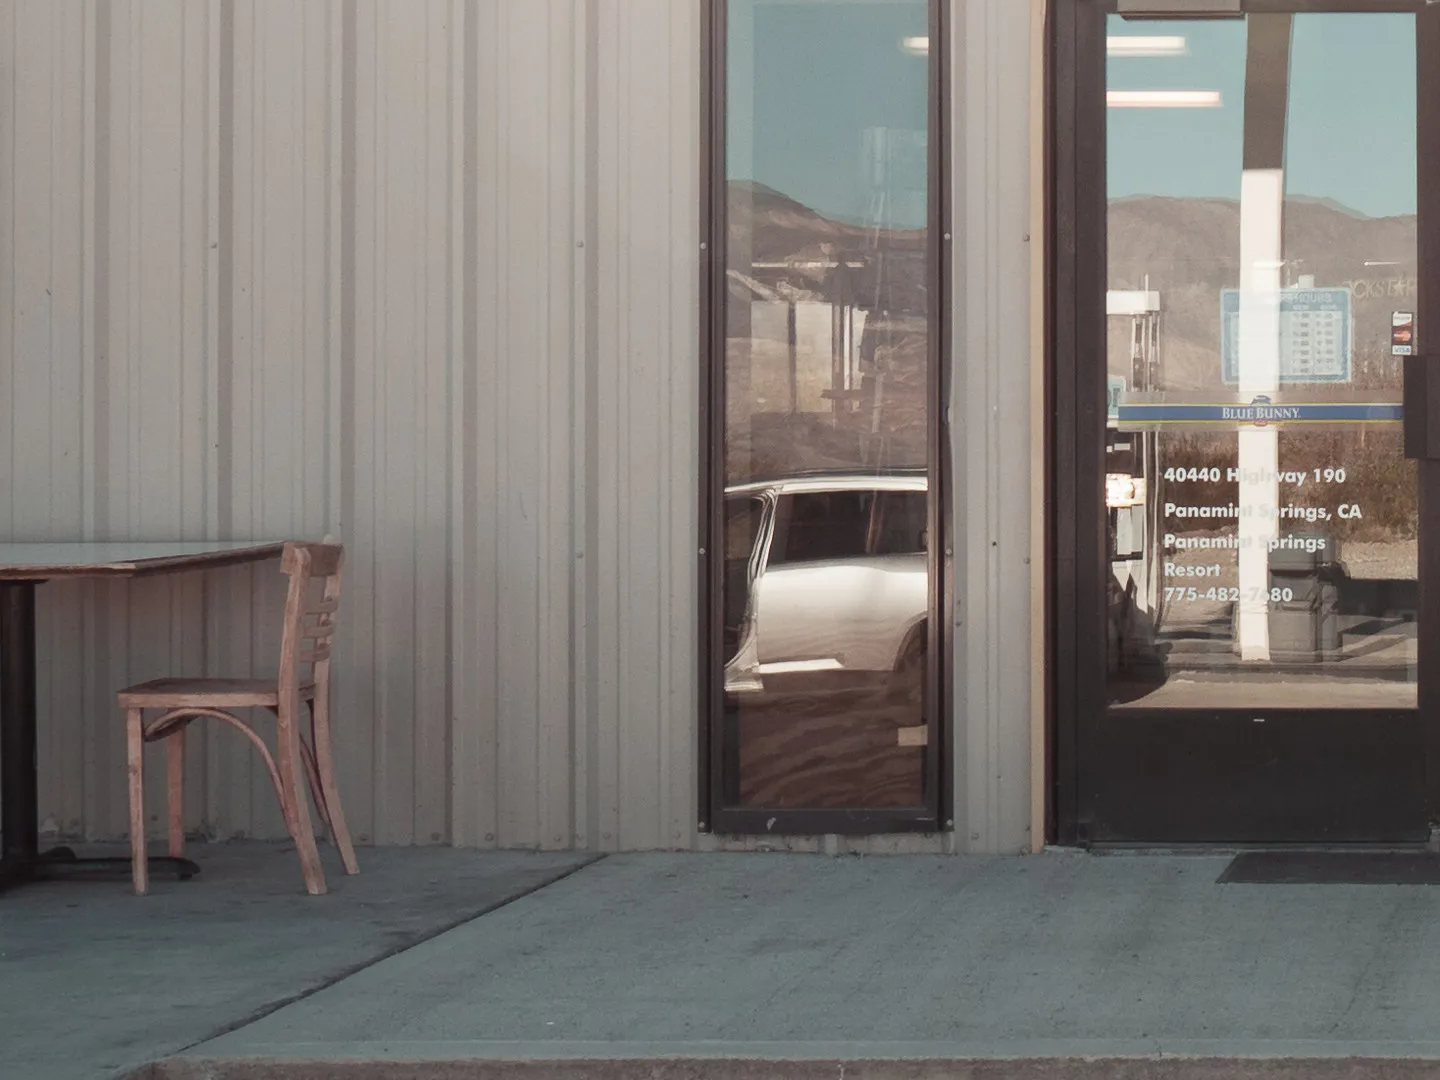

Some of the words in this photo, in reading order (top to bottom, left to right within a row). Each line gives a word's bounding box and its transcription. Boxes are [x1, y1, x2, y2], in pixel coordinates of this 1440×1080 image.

[1222, 407, 1254, 419] BLUE
[1164, 467, 1221, 483] 40440
[1313, 468, 1347, 484] 190
[1337, 504, 1363, 519] CA
[1164, 563, 1221, 577] Resort
